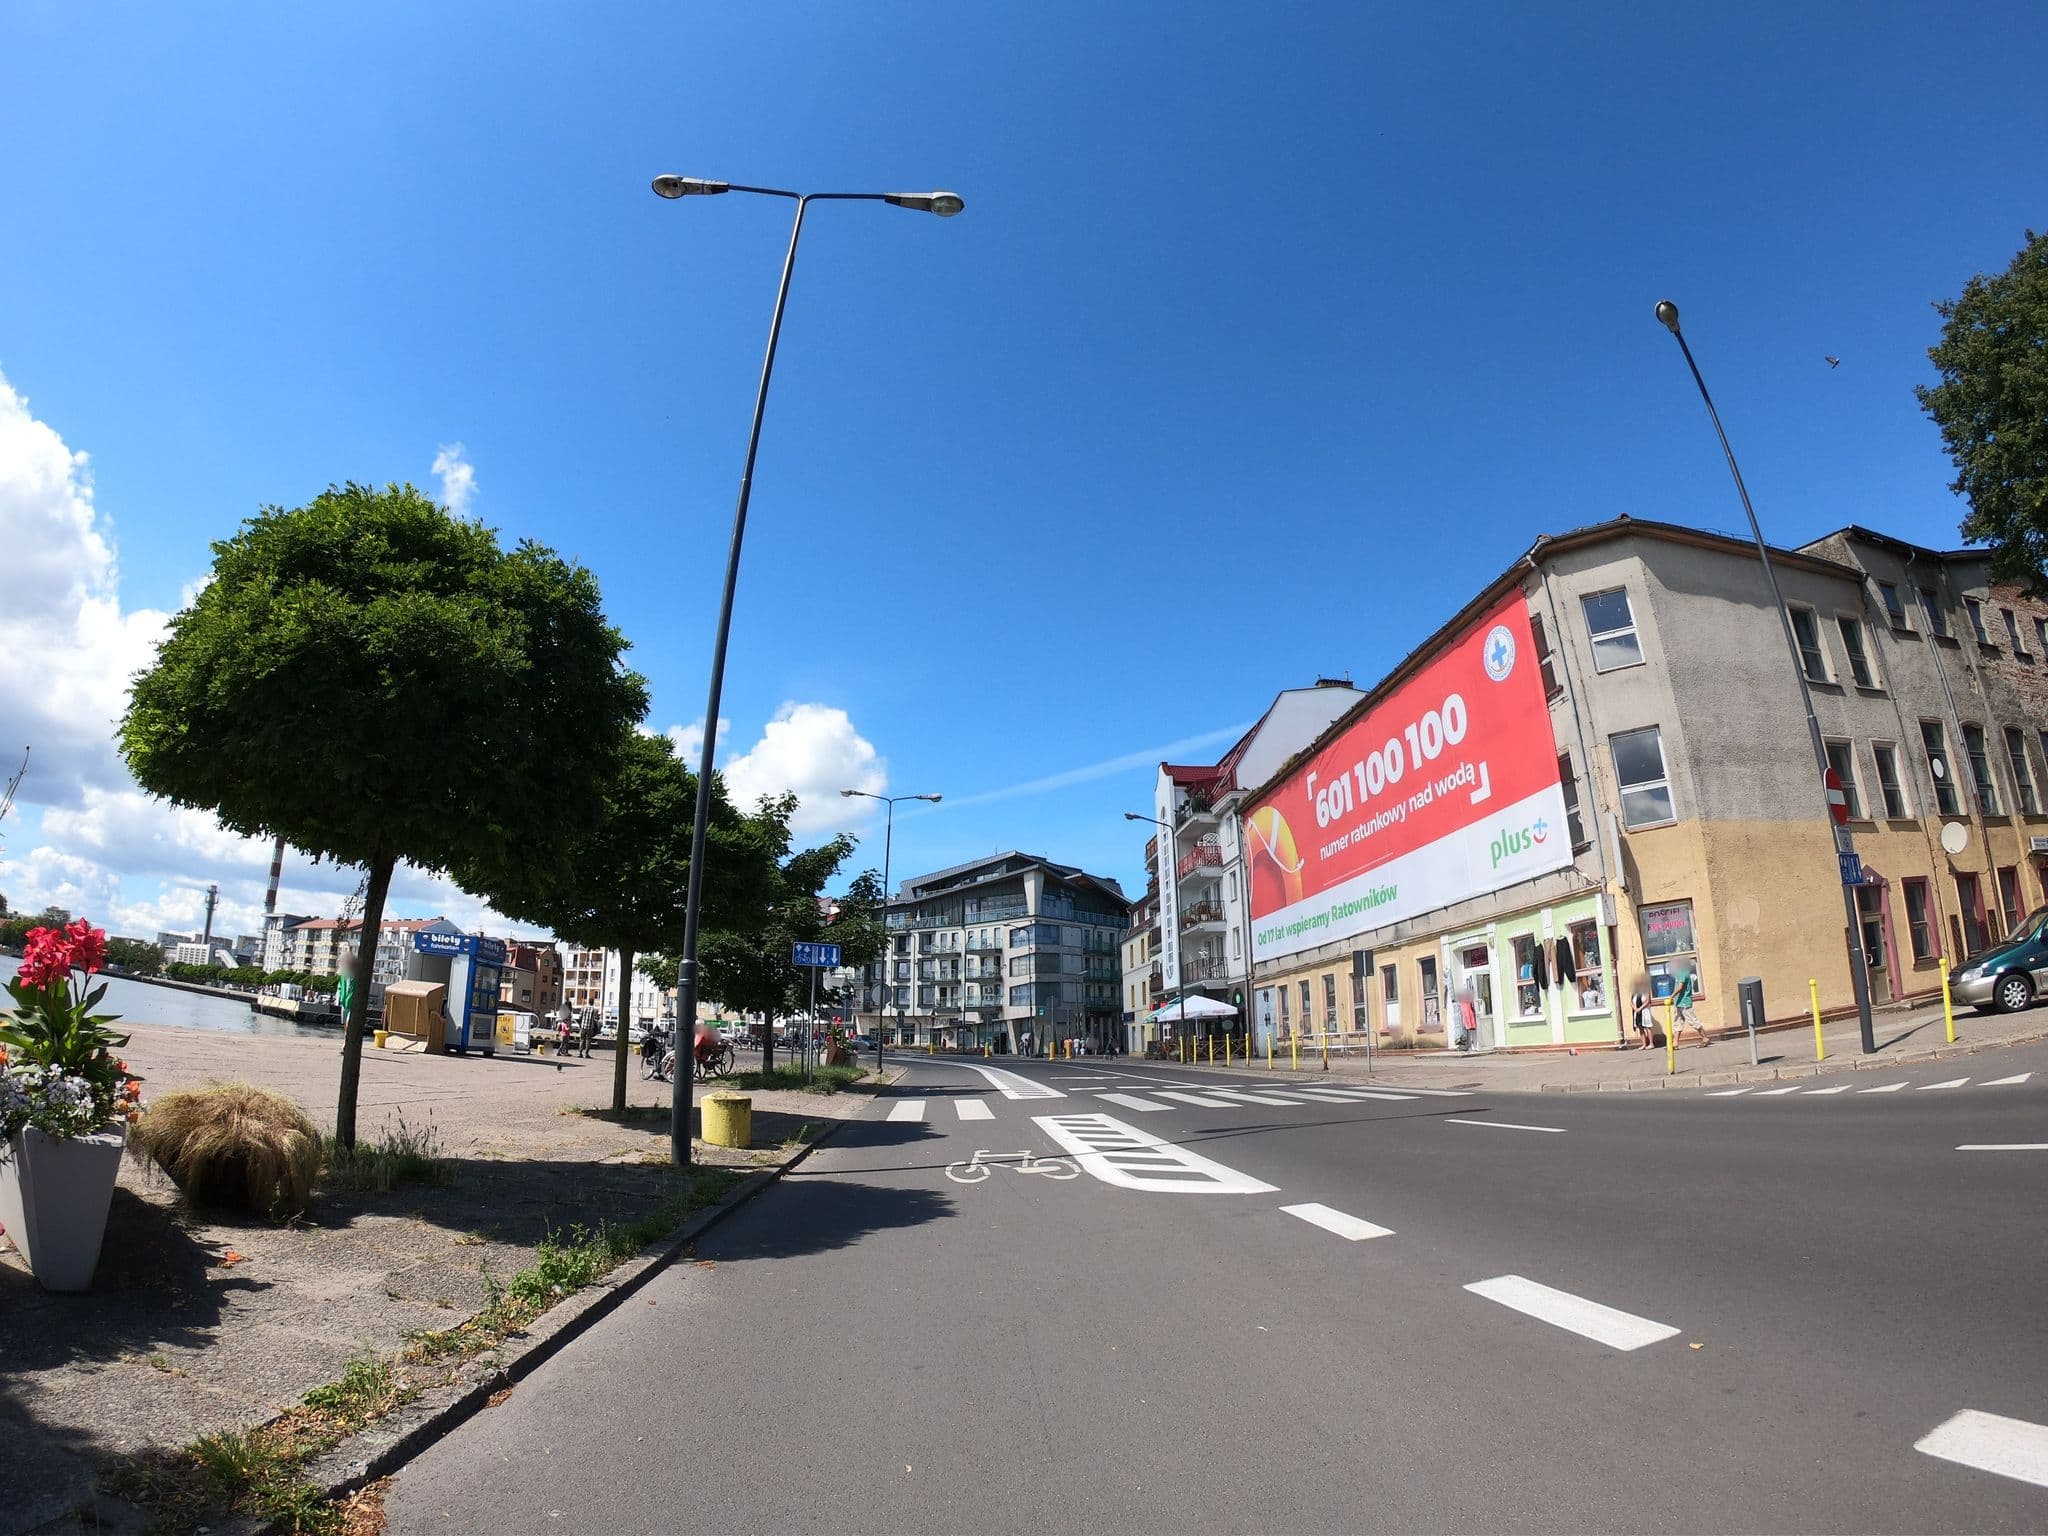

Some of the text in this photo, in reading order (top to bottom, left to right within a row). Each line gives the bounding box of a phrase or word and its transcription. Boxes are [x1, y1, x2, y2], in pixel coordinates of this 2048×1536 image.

[1316, 693, 1467, 828] 601 100 100
[1320, 761, 1476, 861] numer ratunkowy nad wodą
[1491, 828, 1531, 869] plus
[431, 934, 460, 945] bilety
[1257, 930, 1266, 946] Od
[1275, 926, 1285, 941] lat
[1286, 911, 1330, 938] wspieramy
[1331, 885, 1397, 921] Ratowników
